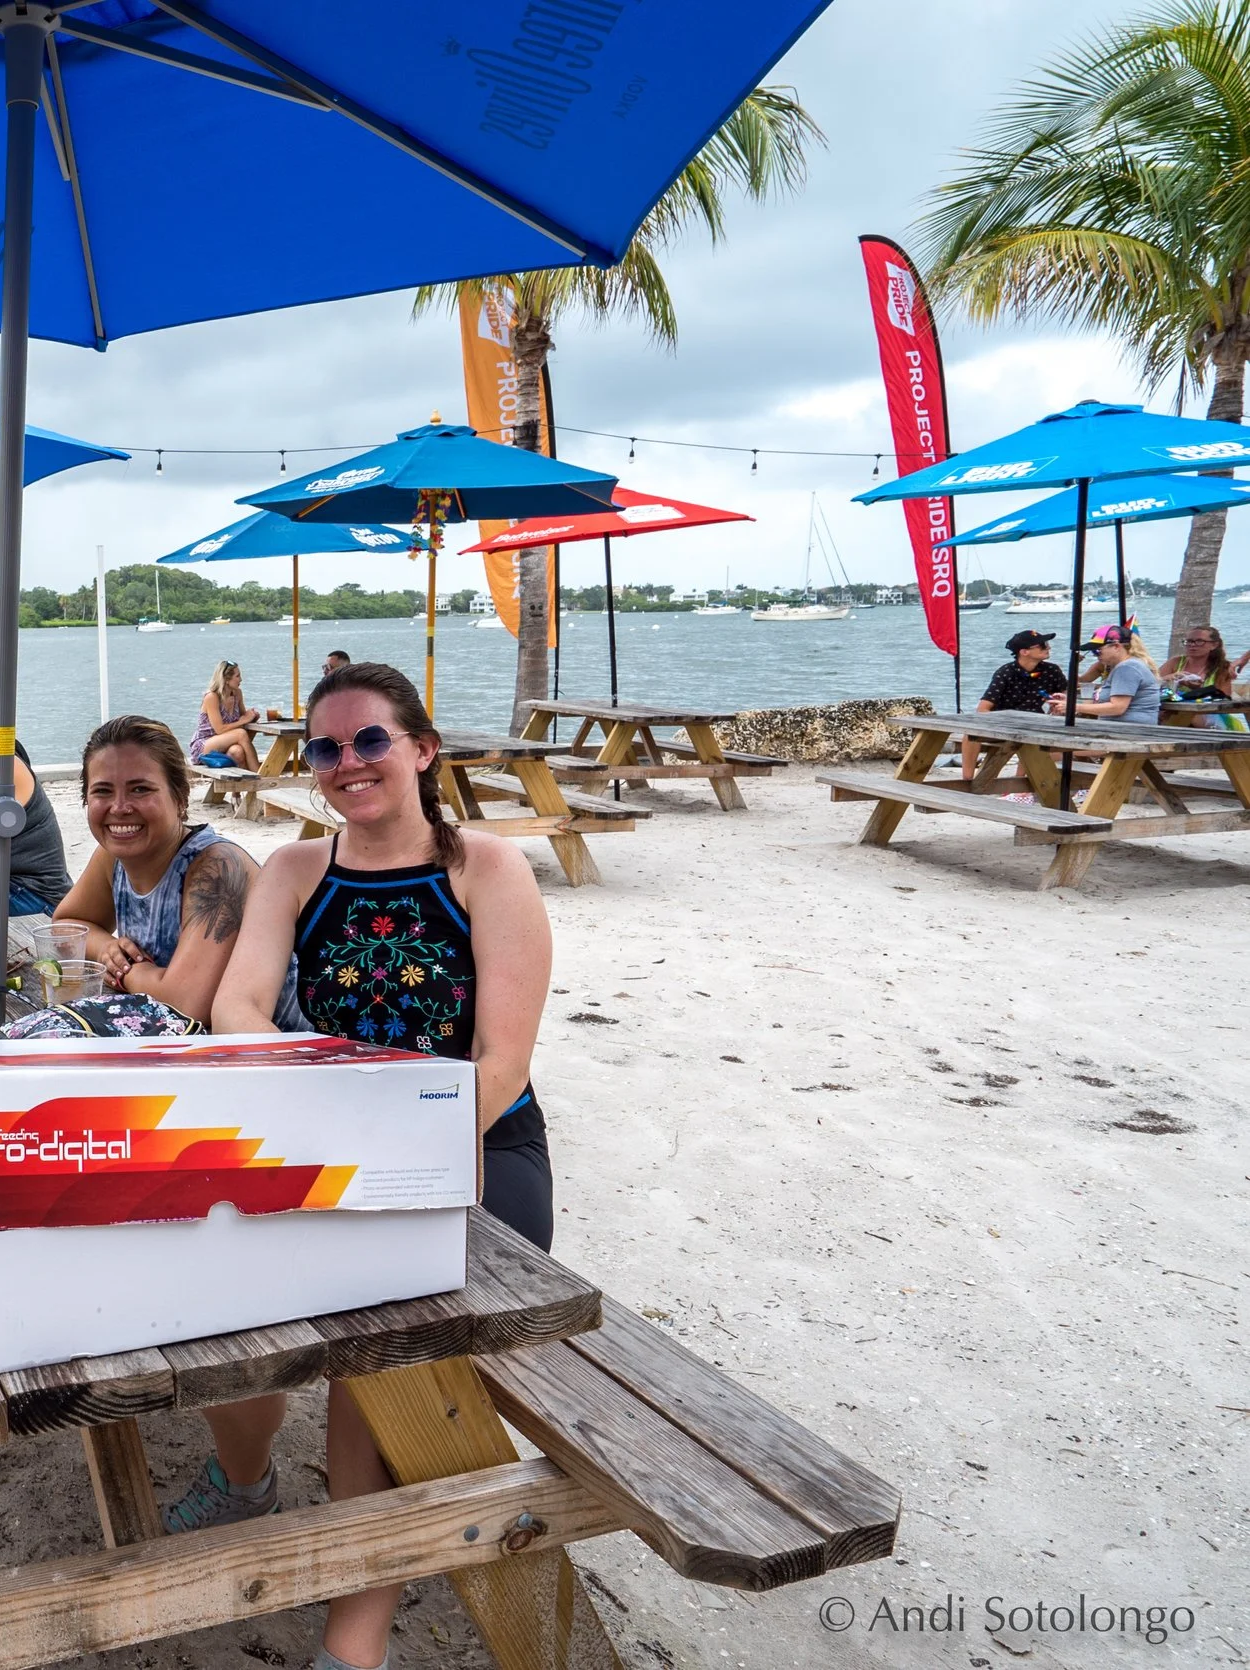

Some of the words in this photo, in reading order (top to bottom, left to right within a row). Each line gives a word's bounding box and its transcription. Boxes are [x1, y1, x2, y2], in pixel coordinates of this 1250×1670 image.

[888, 276, 908, 327] PRIDE
[496, 362, 518, 447] PROJE
[905, 350, 936, 463] PROJECT
[927, 496, 948, 542] IDE
[931, 547, 951, 598] SRQ
[419, 1092, 458, 1100] MOORIM
